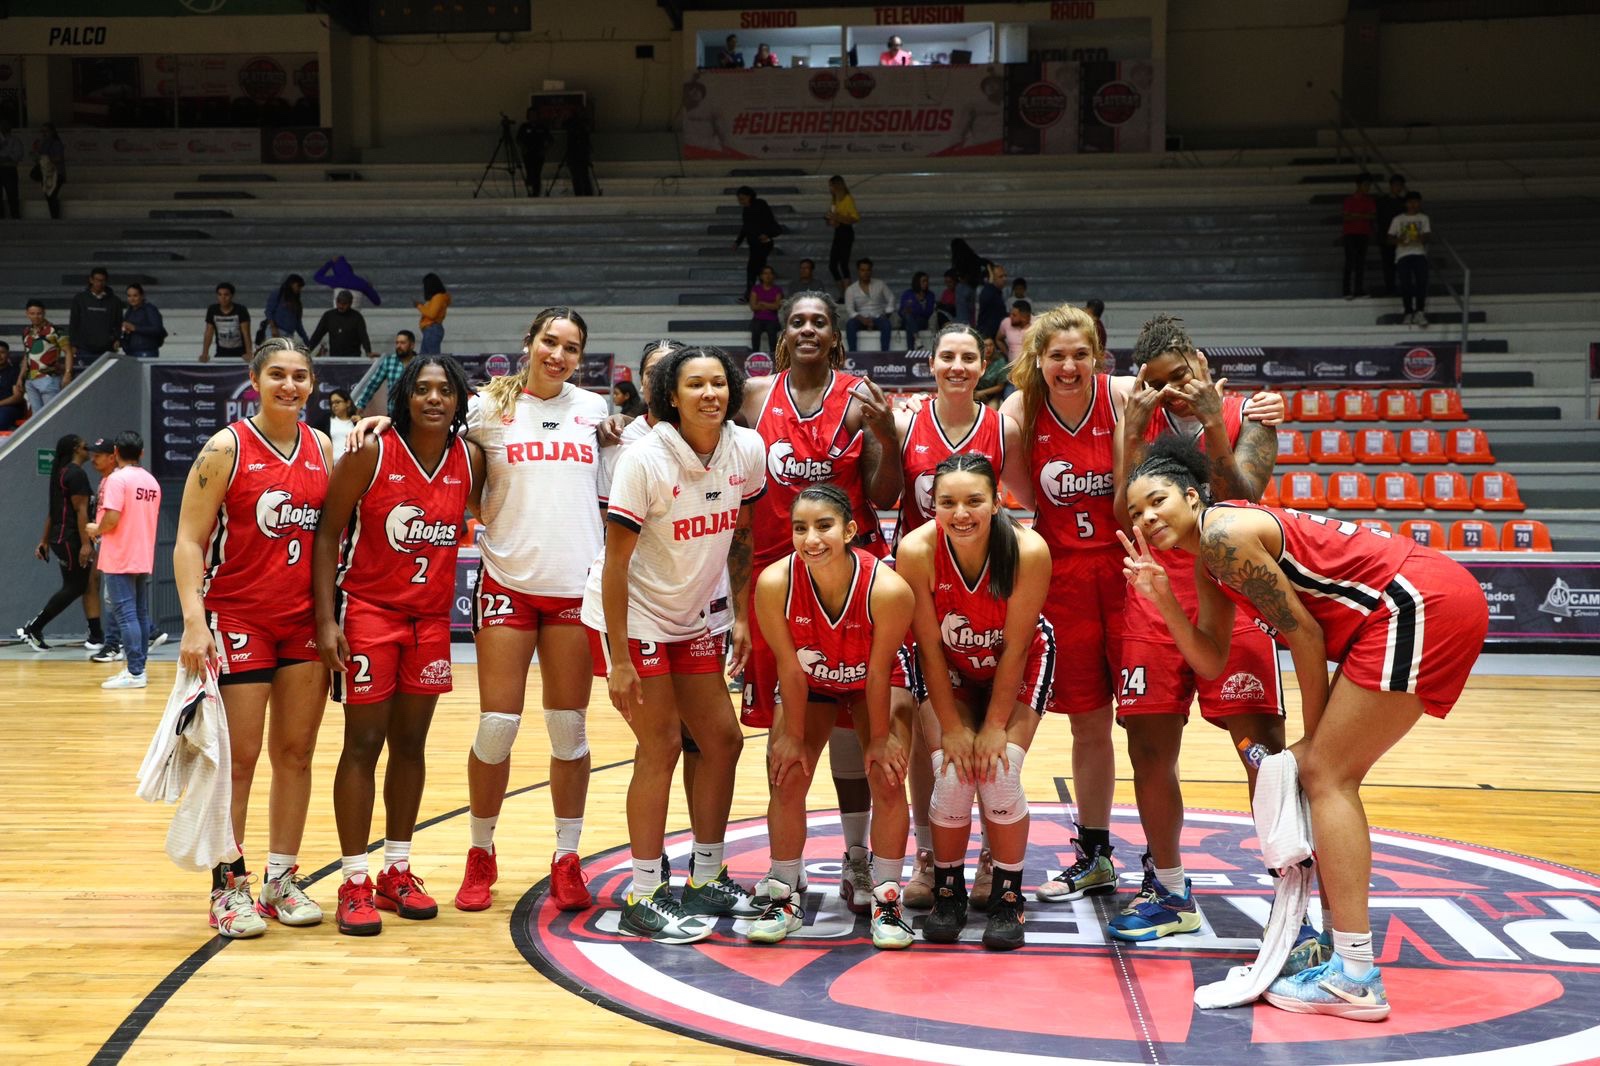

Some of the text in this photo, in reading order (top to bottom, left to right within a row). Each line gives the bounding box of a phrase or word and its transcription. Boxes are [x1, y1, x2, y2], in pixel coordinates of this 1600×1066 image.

[740, 11, 797, 28] SONIDO
[873, 6, 964, 25] TELEVISION
[1050, 2, 1095, 20] RADIO
[49, 27, 107, 46] PALCO
[732, 109, 954, 135] #GUERREROSSOMOS
[873, 364, 907, 373] molten
[1221, 362, 1257, 373] molten
[506, 441, 594, 464] ROJAS
[784, 457, 832, 479] Rojas
[1061, 471, 1114, 496] Rojas
[136, 488, 158, 502] STAFF
[279, 503, 321, 526] Rojas
[408, 520, 457, 543] Rojas
[1075, 512, 1094, 539] 5
[1414, 531, 1427, 541] 72
[1465, 531, 1479, 542] 71
[1516, 532, 1530, 543] 70
[287, 540, 302, 565] 9
[410, 557, 429, 583] 2
[1481, 582, 1493, 590] os
[482, 595, 513, 618] 22
[1570, 593, 1600, 605] CAM
[959, 627, 1003, 648] Rojas
[639, 640, 657, 657] 5
[352, 654, 372, 683] 2
[967, 655, 998, 669] 14
[814, 662, 866, 683] Rojas
[1121, 666, 1146, 696] 24
